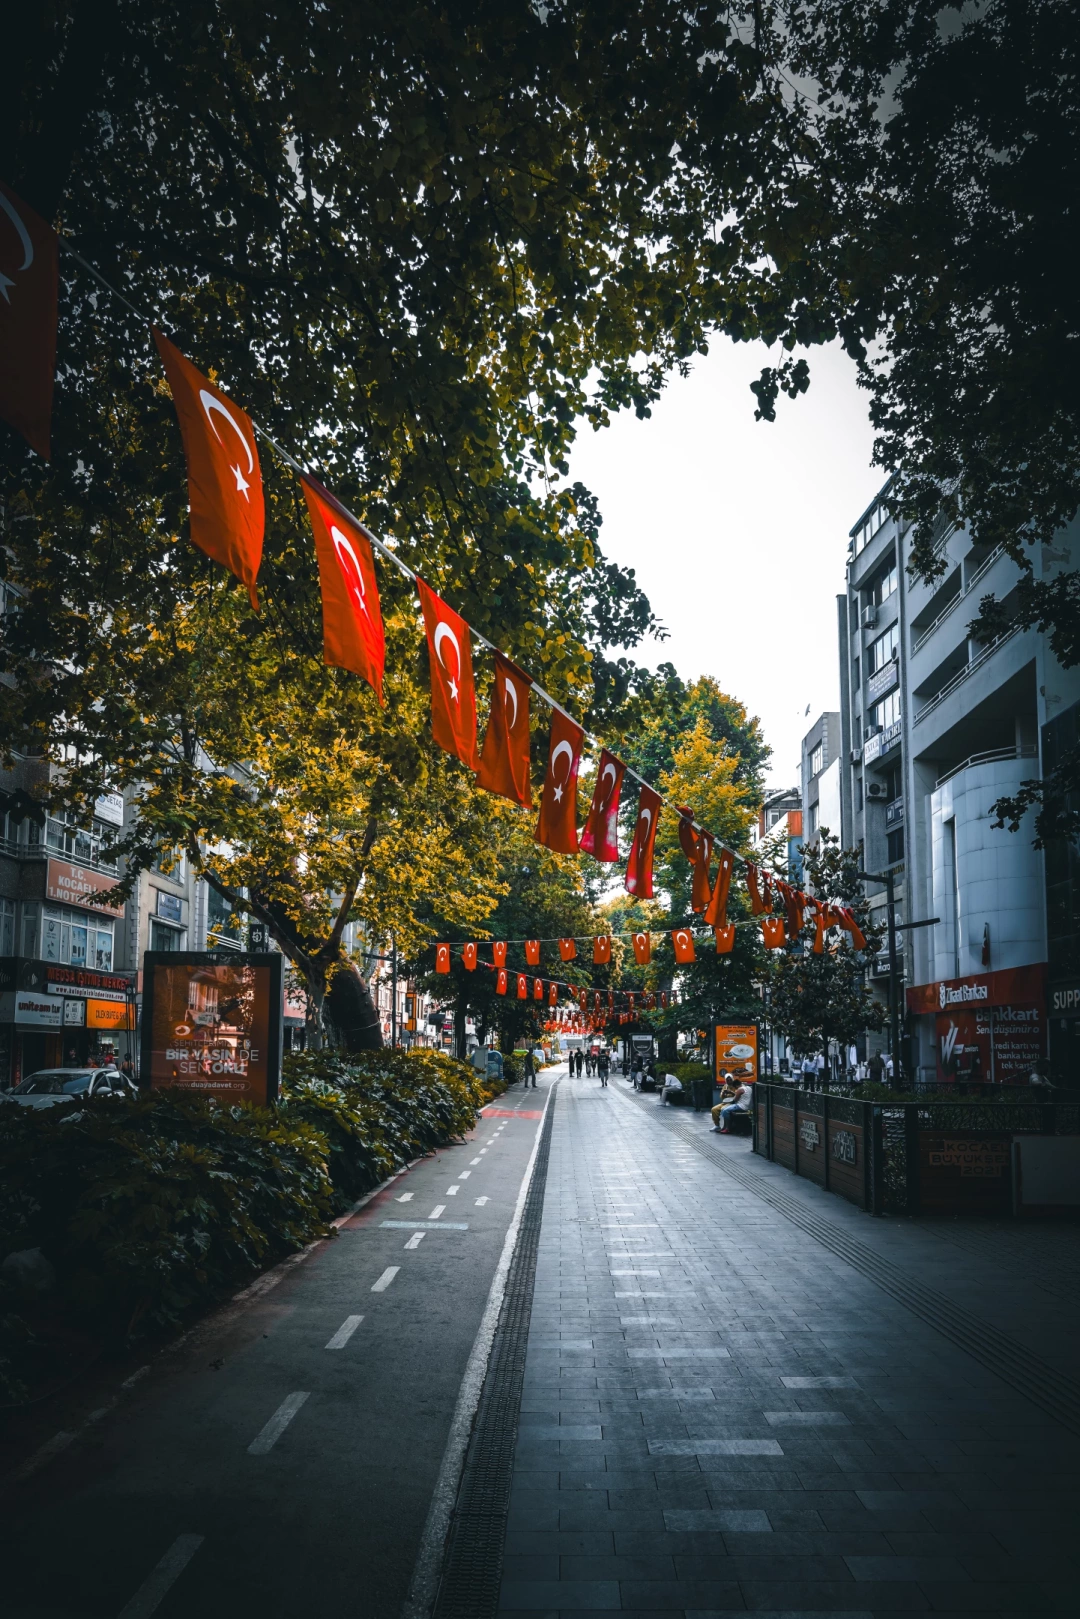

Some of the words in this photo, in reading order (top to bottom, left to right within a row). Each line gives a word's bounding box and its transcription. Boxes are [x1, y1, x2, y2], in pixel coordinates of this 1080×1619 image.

[69, 867, 86, 881] T.C.
[58, 875, 98, 894] KOCAELİ
[945, 986, 963, 1004] Ziraat
[963, 983, 988, 1002] Bankası
[18, 1001, 51, 1013] uniteam
[51, 1003, 61, 1014] tur
[975, 1006, 1039, 1022] Bankkart
[993, 1024, 1032, 1037] düşünür
[1010, 1041, 1029, 1050] kartı
[239, 1049, 260, 1062] DE
[997, 1051, 1021, 1060] banka
[1022, 1051, 1040, 1060] kartı
[179, 1061, 209, 1074] SEN
[212, 1061, 245, 1074] OKU
[1001, 1061, 1014, 1070] tek
[174, 1081, 246, 1090] www.duayadavet.org
[946, 1143, 1009, 1152] KOCAEL
[963, 1166, 1000, 1175] 2021
